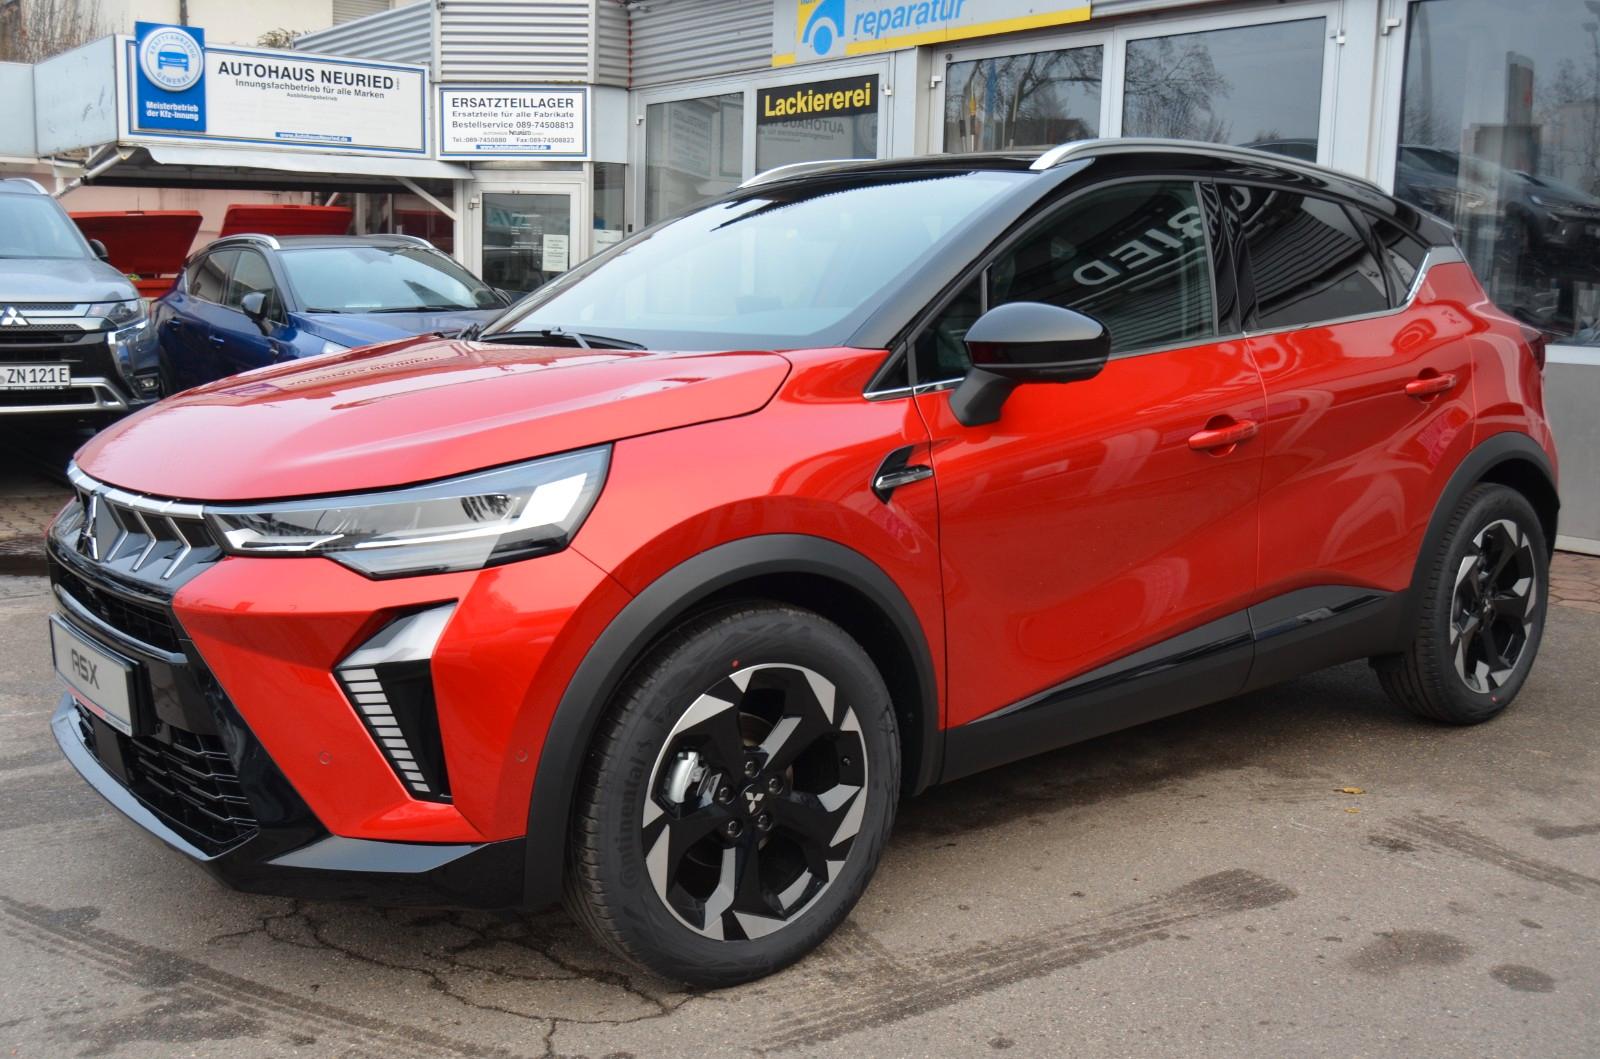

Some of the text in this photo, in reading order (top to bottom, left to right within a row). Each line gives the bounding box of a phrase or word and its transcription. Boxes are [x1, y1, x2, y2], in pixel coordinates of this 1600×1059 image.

[853, 0, 965, 39] reparatur
[218, 61, 315, 82] AUTOHAUS
[321, 69, 394, 89] NEURIED
[235, 79, 385, 99] Innungsfachbetrieb für alle Marken
[145, 100, 199, 112] Meisterbetrieb
[452, 97, 574, 108] ERSATZTEILLAGER
[764, 82, 871, 117] Lackiererei
[160, 110, 199, 121] Kfz-Innung
[452, 121, 574, 129] Bestellservice 089-74508813
[7, 368, 26, 384] ZN
